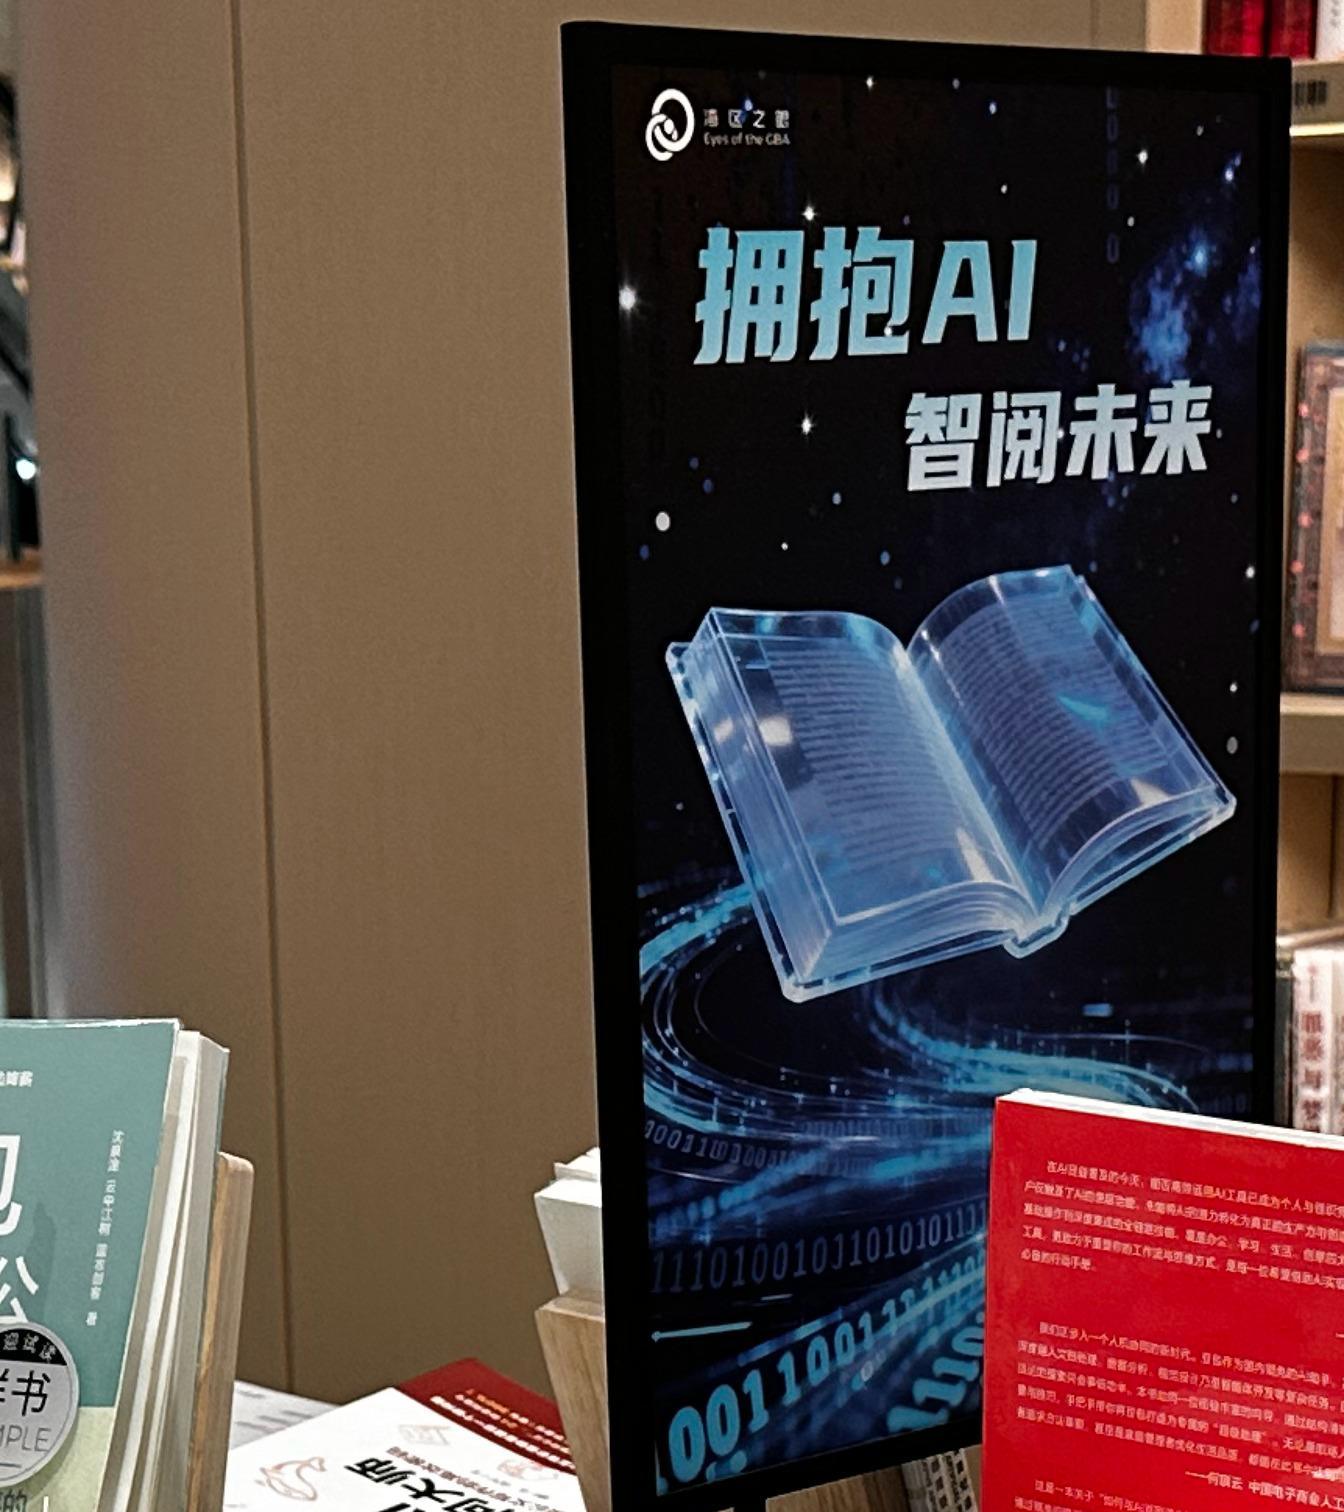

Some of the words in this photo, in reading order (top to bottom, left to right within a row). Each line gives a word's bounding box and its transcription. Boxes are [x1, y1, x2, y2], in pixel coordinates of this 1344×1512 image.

[693, 226, 1038, 365] 拥抱AI
[904, 379, 1213, 492] 智阅未来
